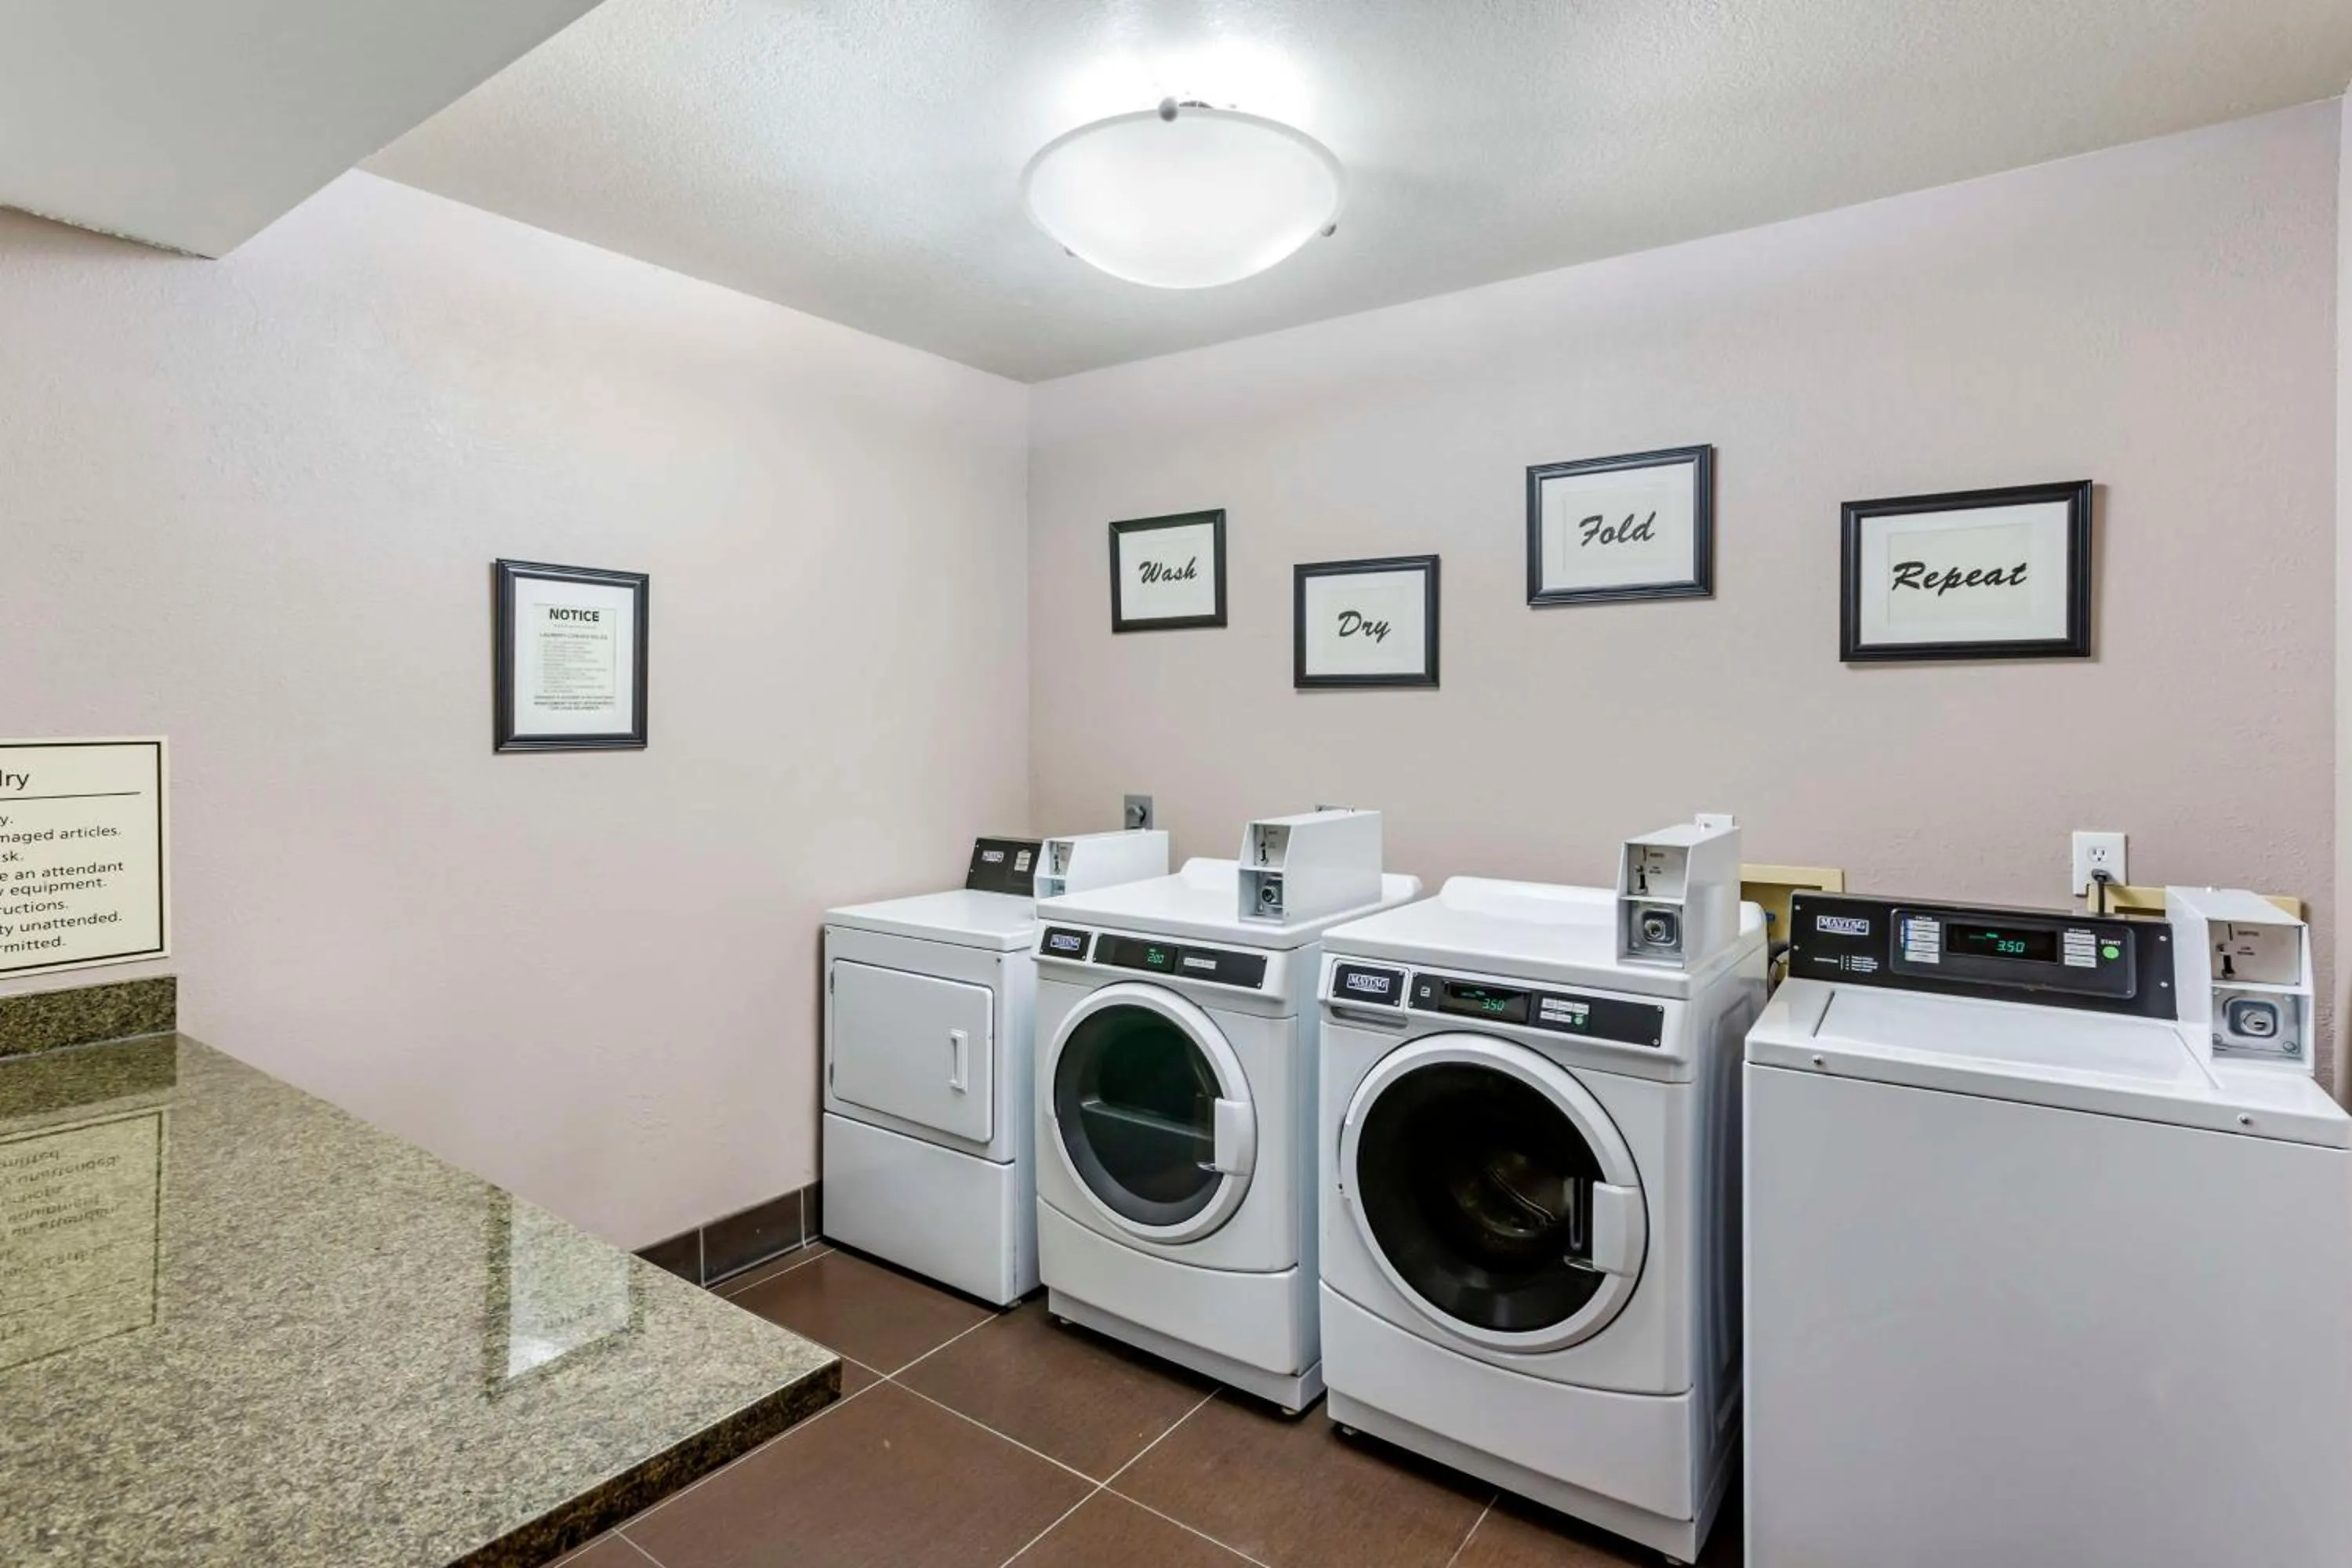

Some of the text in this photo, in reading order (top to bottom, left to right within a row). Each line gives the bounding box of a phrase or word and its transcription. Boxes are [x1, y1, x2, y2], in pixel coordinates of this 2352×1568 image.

[1579, 511, 1657, 547] Fold
[1139, 557, 1197, 584] Wash
[1892, 561, 2027, 597] Repeat
[550, 608, 600, 622] NOTICE
[1338, 611, 1392, 644] Dry
[0, 769, 30, 791] ry
[60, 826, 122, 840] articles.
[15, 870, 35, 880] an
[42, 862, 124, 877] attendant
[10, 877, 107, 897] equipment.
[0, 901, 68, 915] uctions.
[20, 911, 122, 932] unattended.
[1819, 917, 1867, 931] MAYTAG
